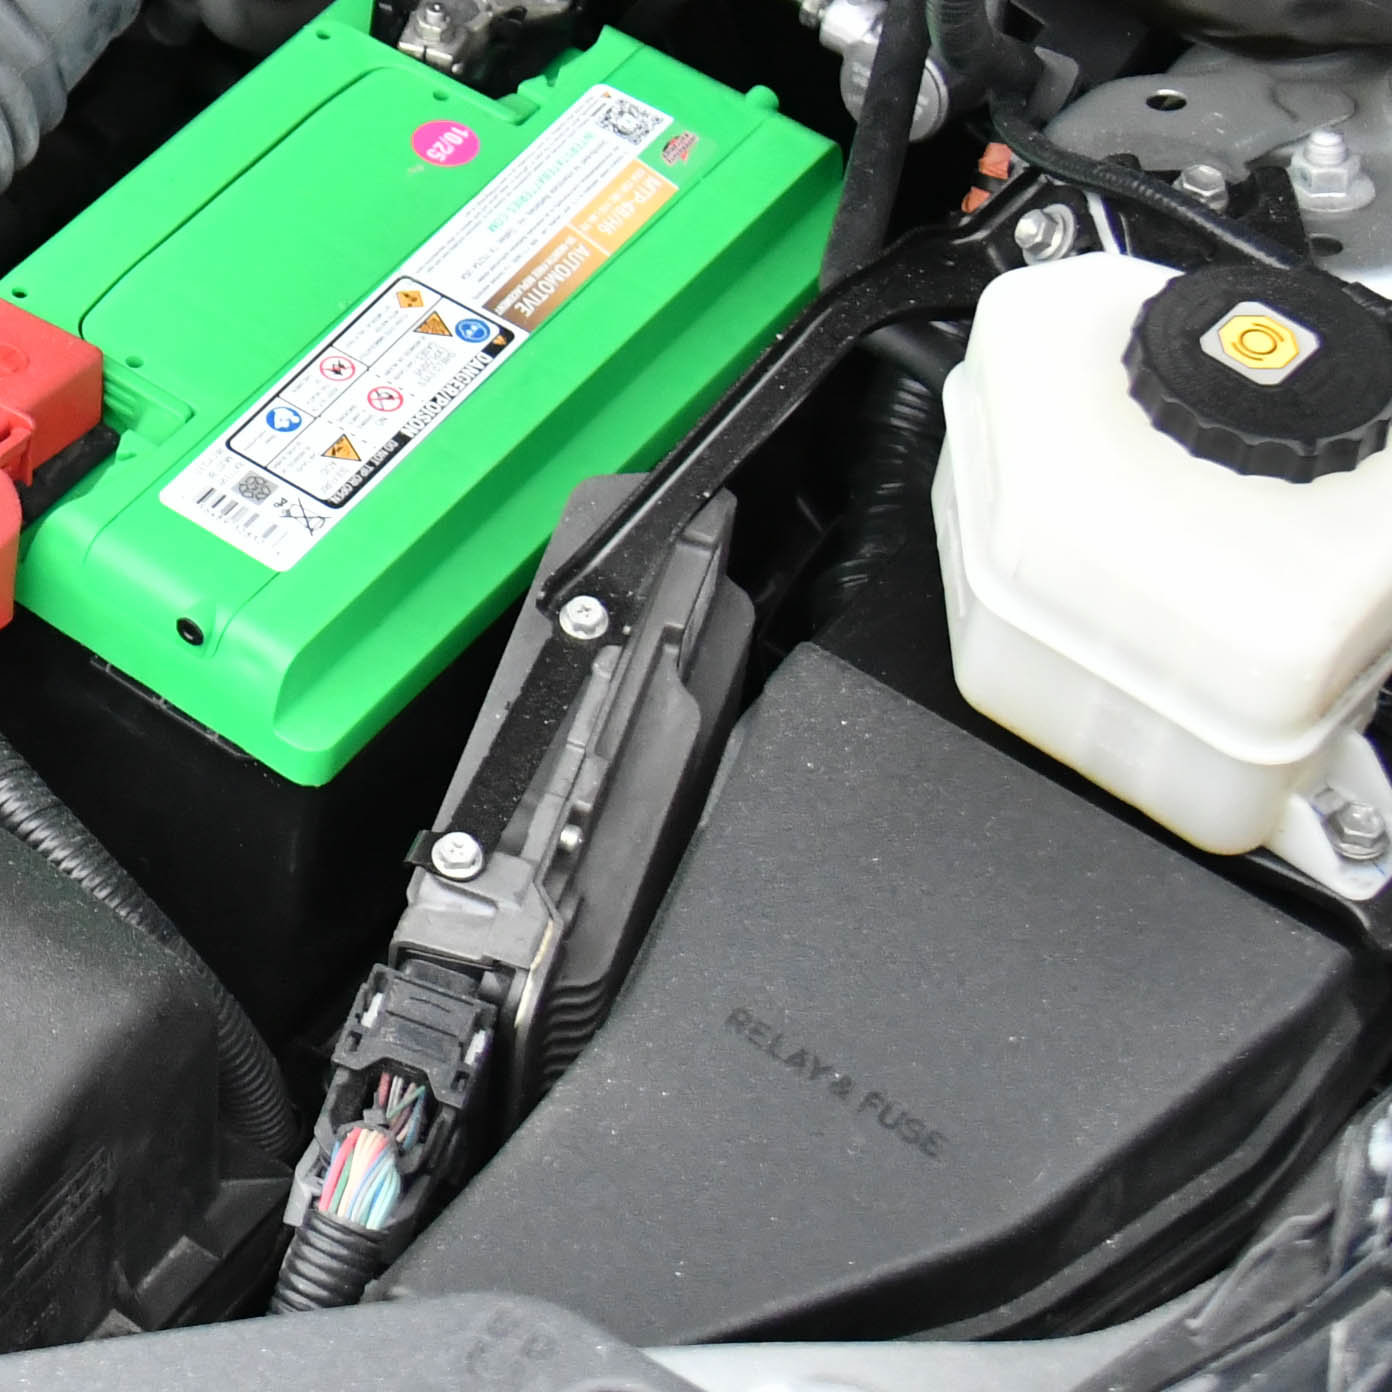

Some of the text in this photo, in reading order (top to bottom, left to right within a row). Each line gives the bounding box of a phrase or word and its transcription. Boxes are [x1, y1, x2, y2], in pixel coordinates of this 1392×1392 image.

[426, 126, 470, 162] 10/25
[514, 244, 591, 318] AUTOMOTIVE
[400, 352, 490, 438] DANGER/POISON
[370, 447, 389, 466] NOT
[381, 439, 398, 452] DO
[346, 473, 362, 486] OR
[357, 461, 374, 476] TIP
[327, 482, 352, 504] OPEN
[724, 1007, 833, 1081] RELAY
[857, 1090, 948, 1157] FUSE
